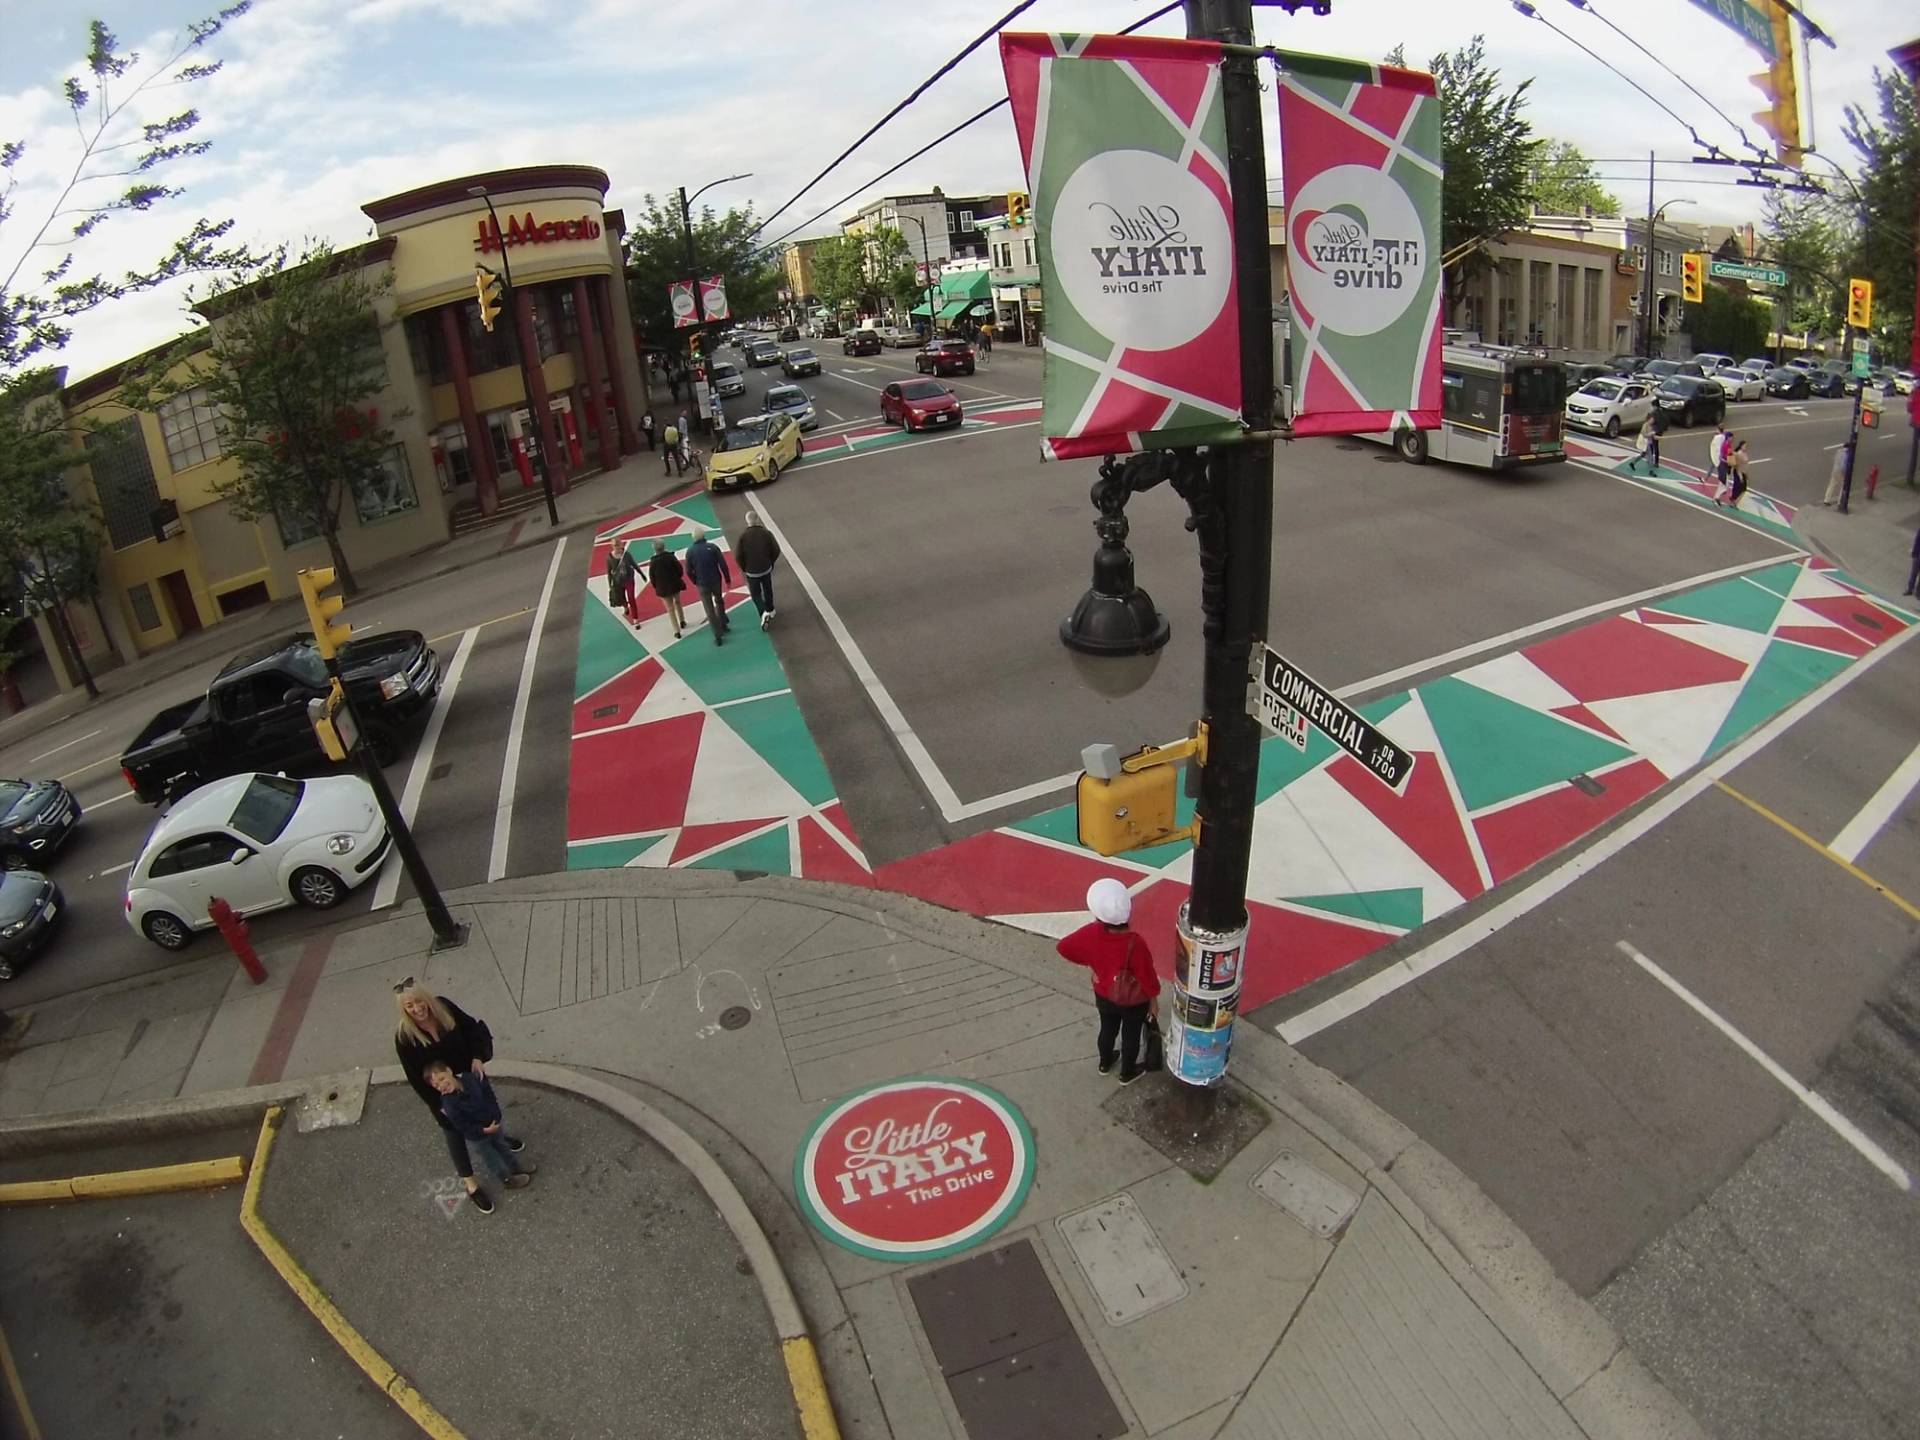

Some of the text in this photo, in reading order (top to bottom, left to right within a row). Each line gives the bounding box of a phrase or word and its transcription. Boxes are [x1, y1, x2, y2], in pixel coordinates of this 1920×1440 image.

[1742, 6, 1769, 47] Ave
[507, 211, 600, 248] Mercato
[1715, 264, 1780, 283] Commercial Dr
[1272, 663, 1364, 755] COMMERCIAL
[1271, 716, 1305, 746] drive
[1370, 753, 1395, 779] 1700
[1381, 745, 1394, 763] DR
[844, 1099, 961, 1169] Little
[835, 1131, 988, 1204] ITALY
[906, 1169, 995, 1204] The Drive
